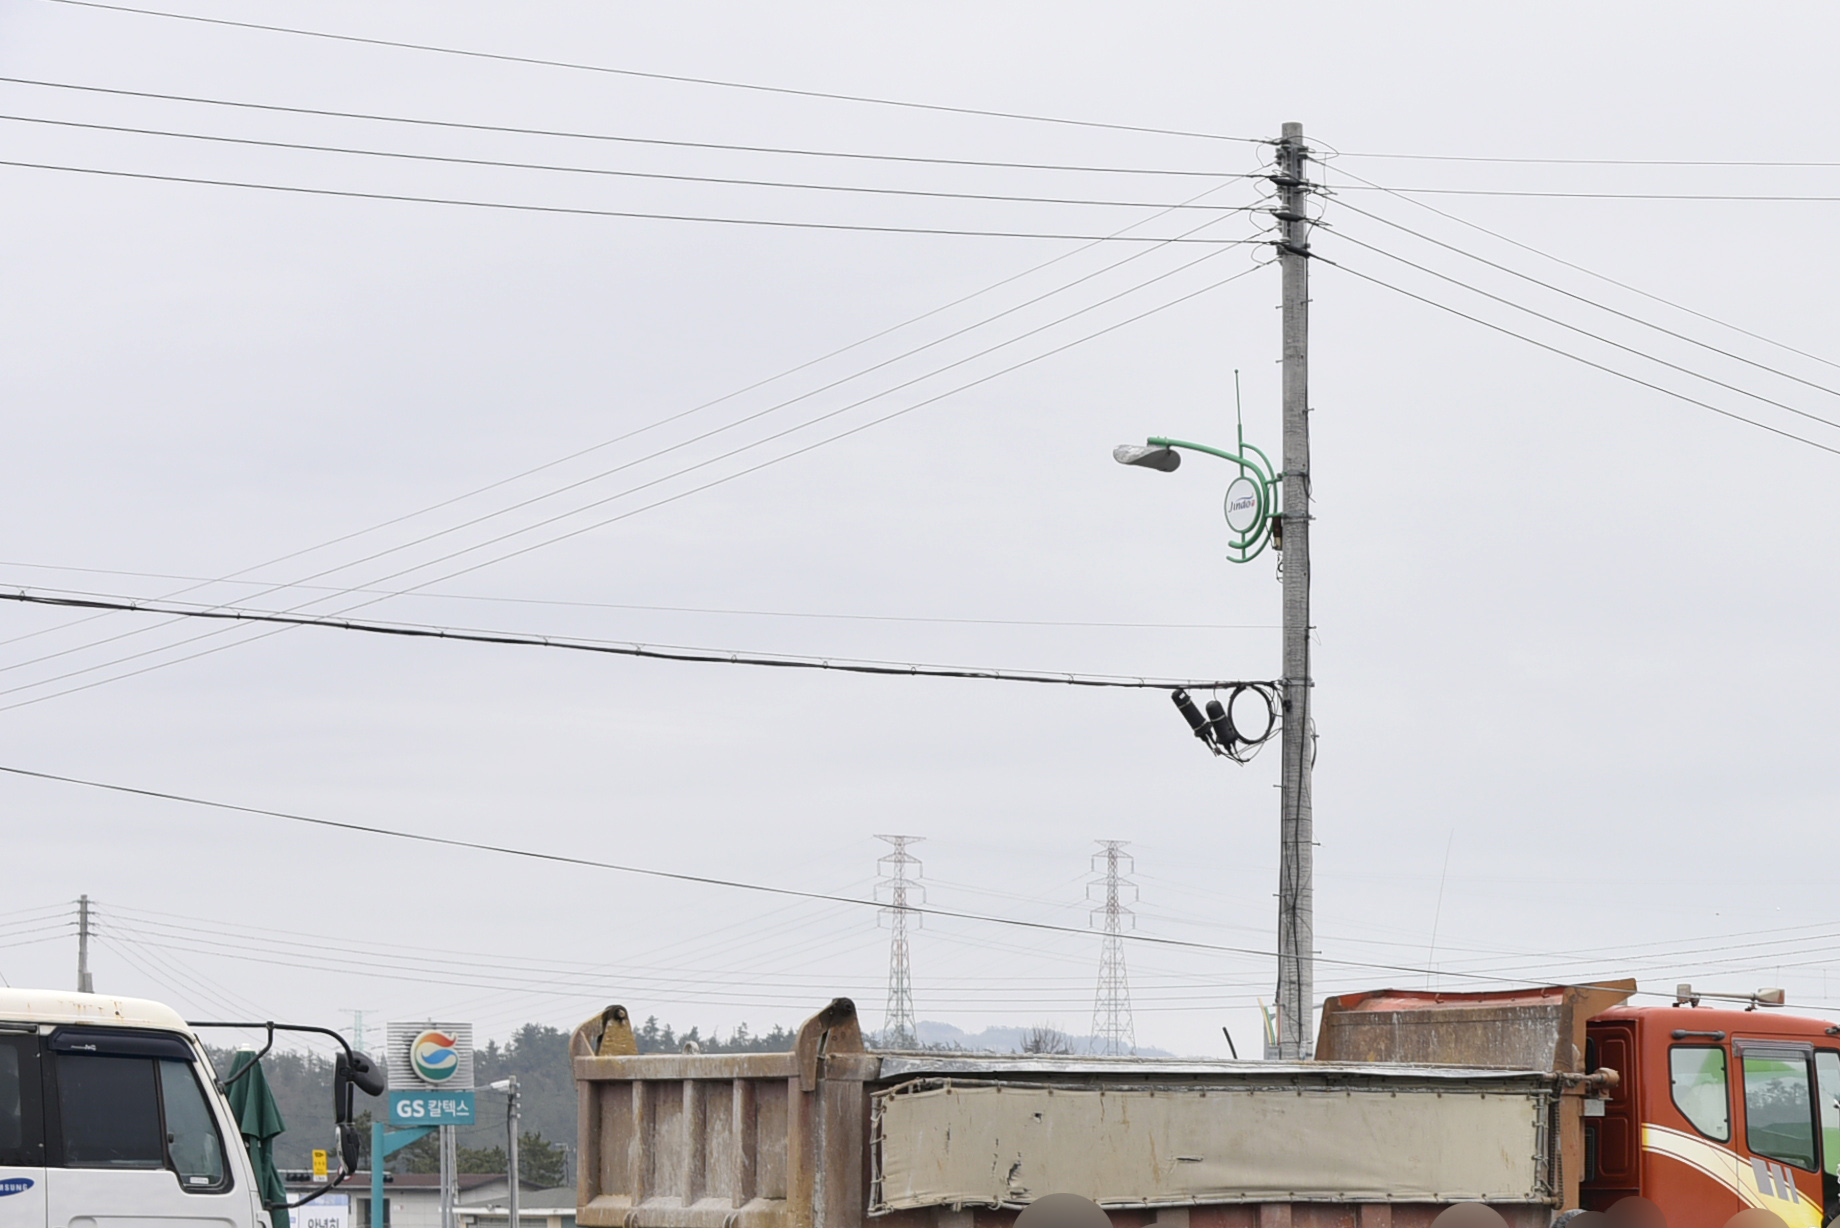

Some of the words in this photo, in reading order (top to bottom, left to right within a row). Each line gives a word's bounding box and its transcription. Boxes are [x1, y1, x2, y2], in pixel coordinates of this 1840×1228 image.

[1228, 500, 1251, 513] Jindo
[396, 1099, 425, 1118] GS
[428, 1099, 470, 1118] 칼텍스
